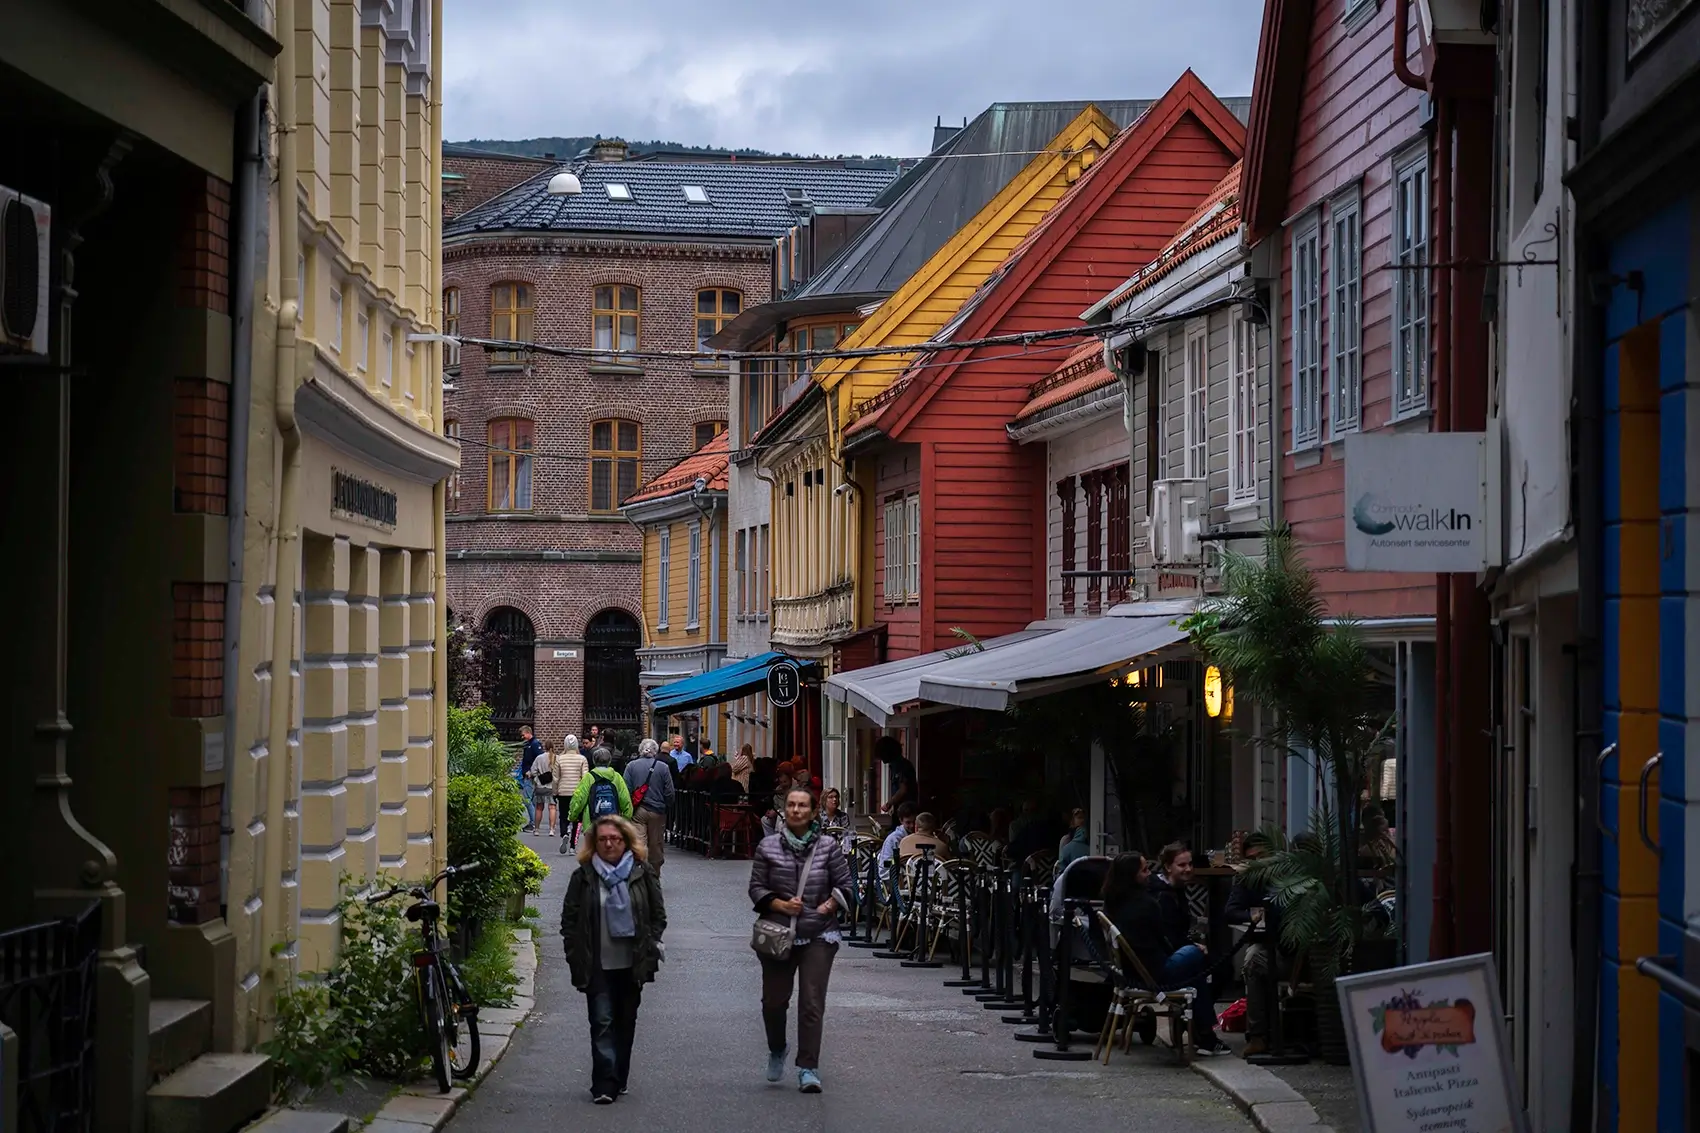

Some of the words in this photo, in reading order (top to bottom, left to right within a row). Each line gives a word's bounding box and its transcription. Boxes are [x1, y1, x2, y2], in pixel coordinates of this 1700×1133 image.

[1395, 508, 1471, 531] walkIn
[1370, 538, 1412, 547] Autorisert
[1414, 538, 1471, 547] servicesenter
[1407, 1063, 1461, 1081] Antipasti
[1394, 1082, 1444, 1099] Italiensk
[1447, 1078, 1479, 1091] Pizza
[1406, 1098, 1474, 1122] Sydeuropeisk
[1419, 1115, 1467, 1133] stemning
